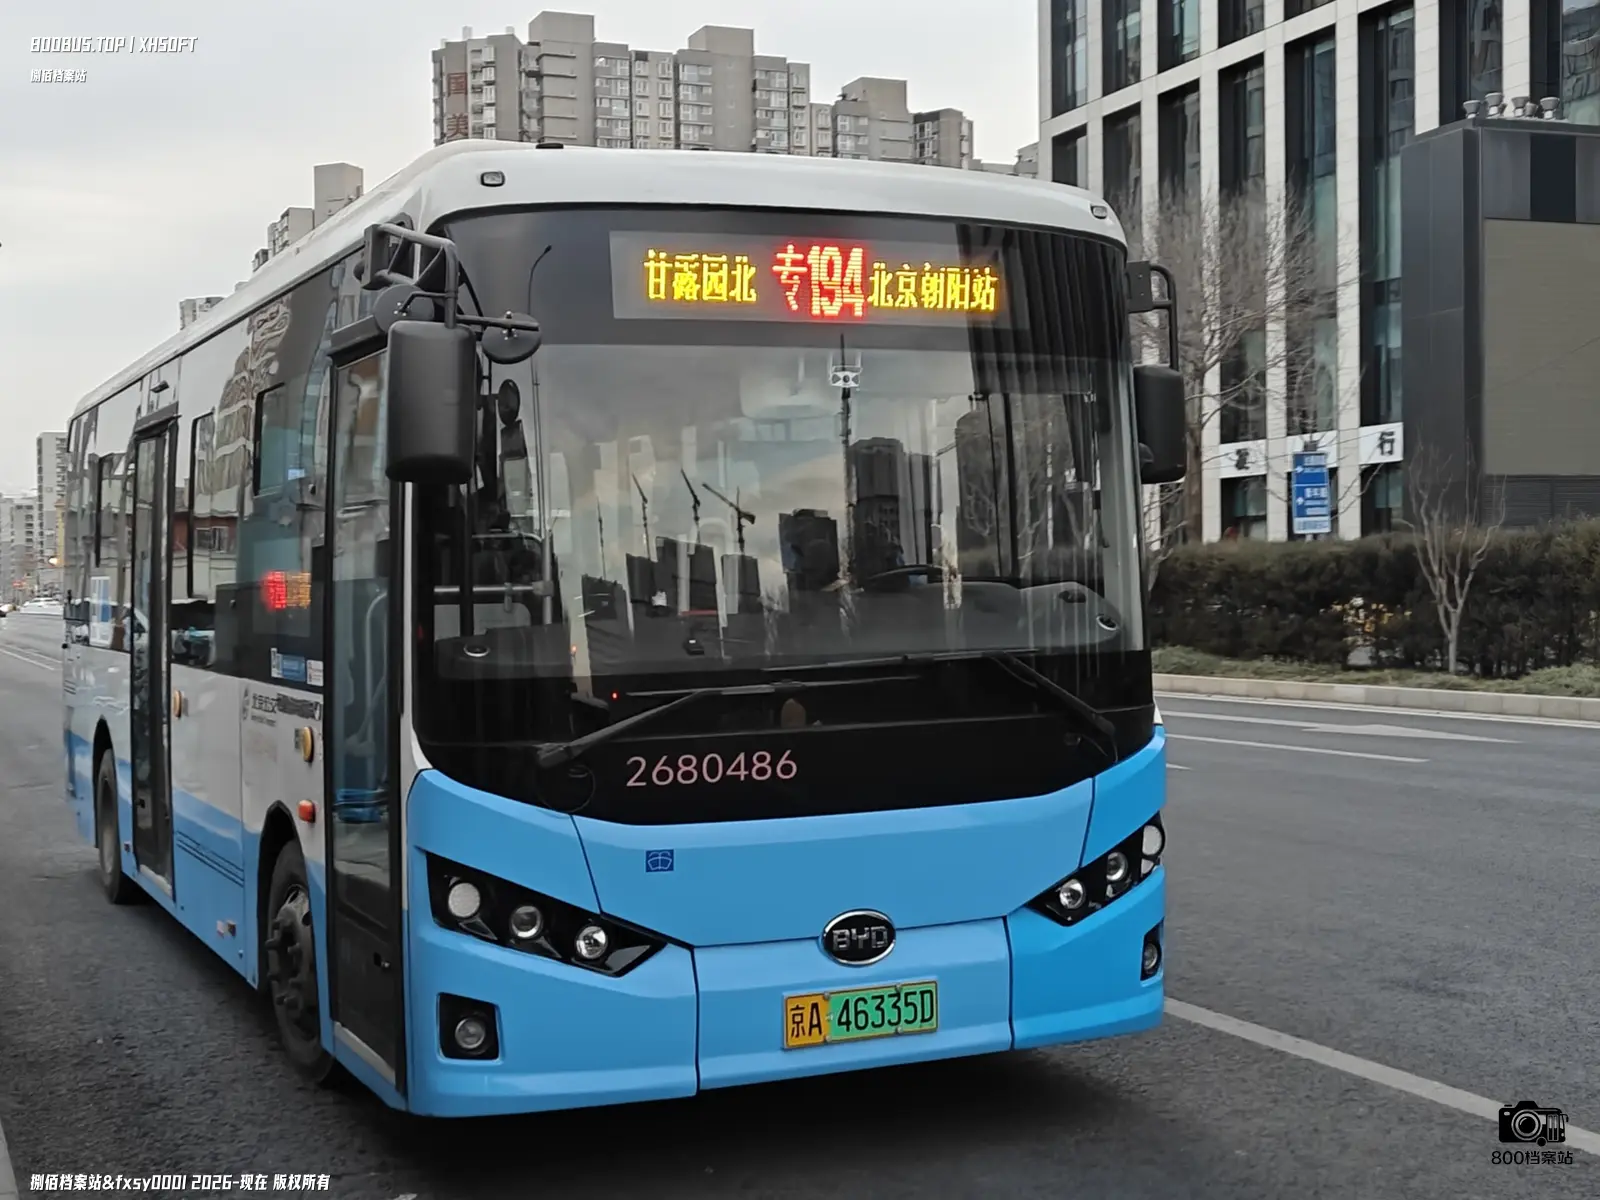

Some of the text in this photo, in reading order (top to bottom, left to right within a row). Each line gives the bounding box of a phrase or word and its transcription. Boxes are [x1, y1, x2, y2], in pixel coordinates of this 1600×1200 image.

[643, 248, 757, 302] 甘露园北
[867, 261, 998, 311] 北京朝阳站
[625, 750, 798, 787] 2680486
[832, 926, 888, 950] BYD
